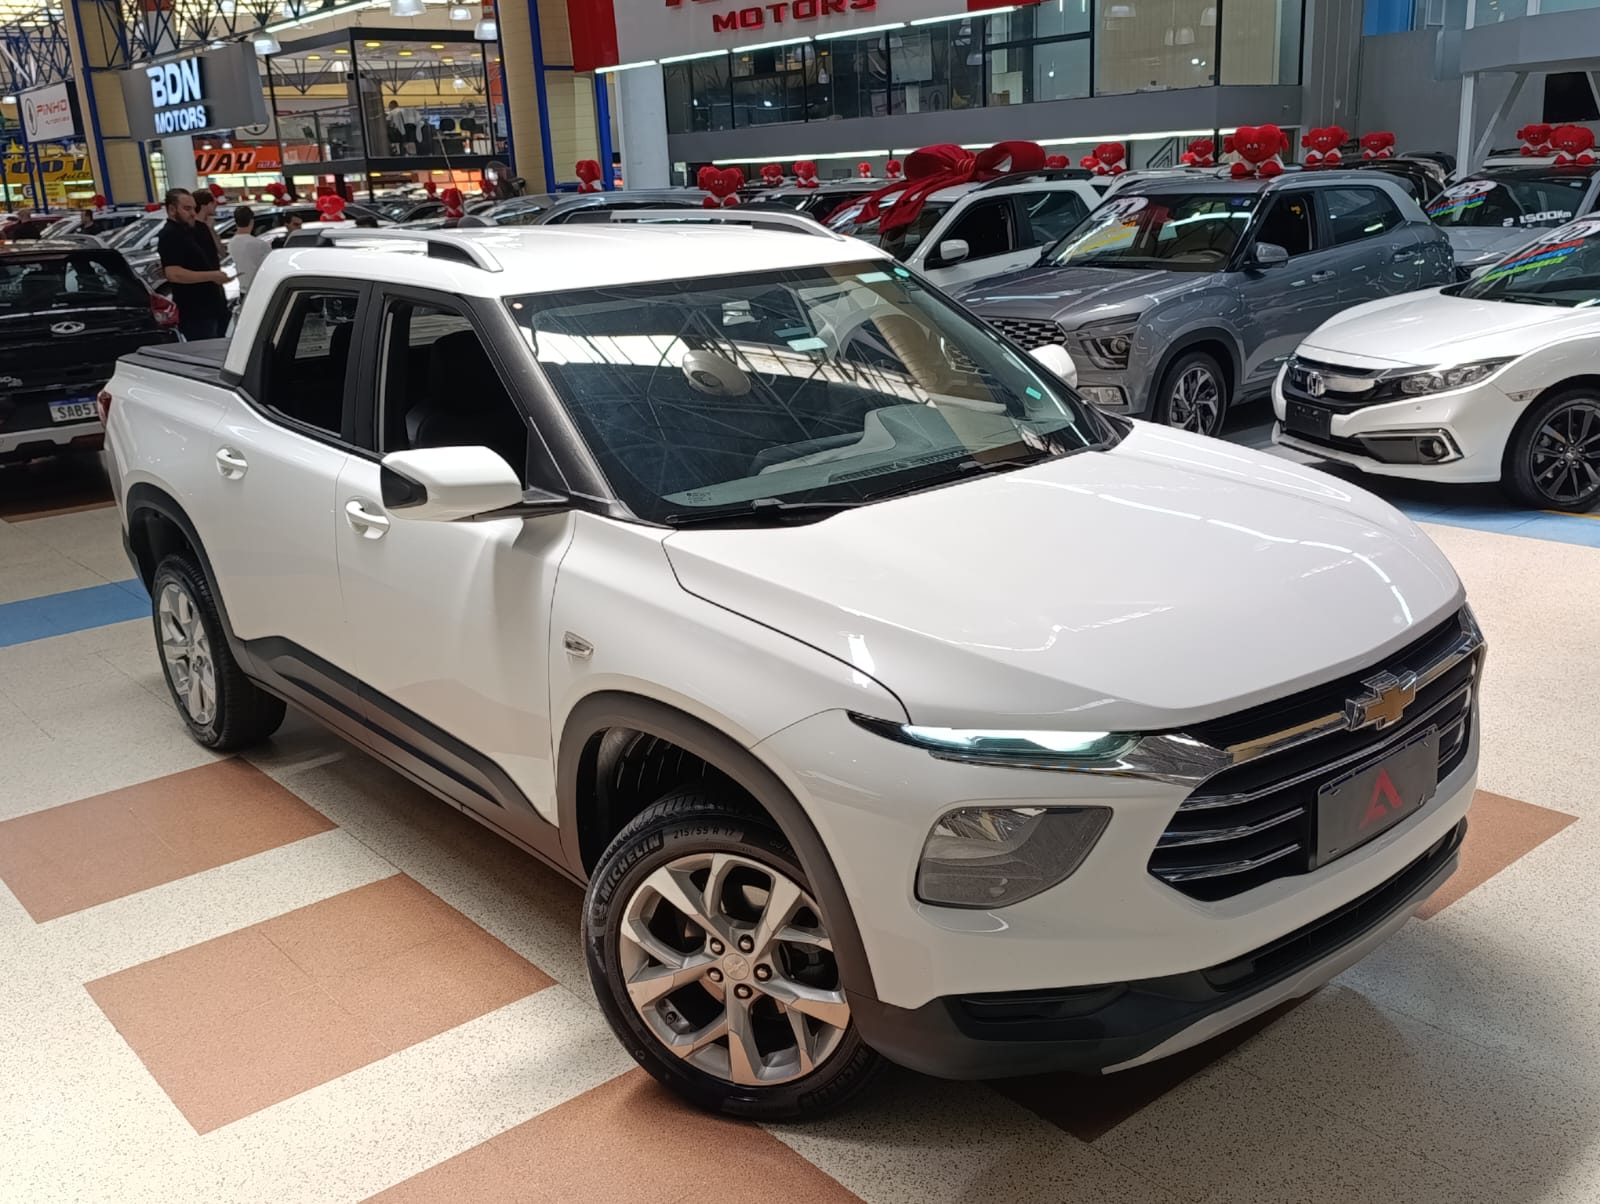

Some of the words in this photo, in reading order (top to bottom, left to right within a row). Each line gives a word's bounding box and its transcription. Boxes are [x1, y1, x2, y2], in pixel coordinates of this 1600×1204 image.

[712, 0, 877, 32] MOTORS
[146, 57, 201, 107] BDN
[36, 99, 67, 117] PINHO
[154, 105, 206, 134] MOTORS
[600, 831, 661, 901] MICHELIN
